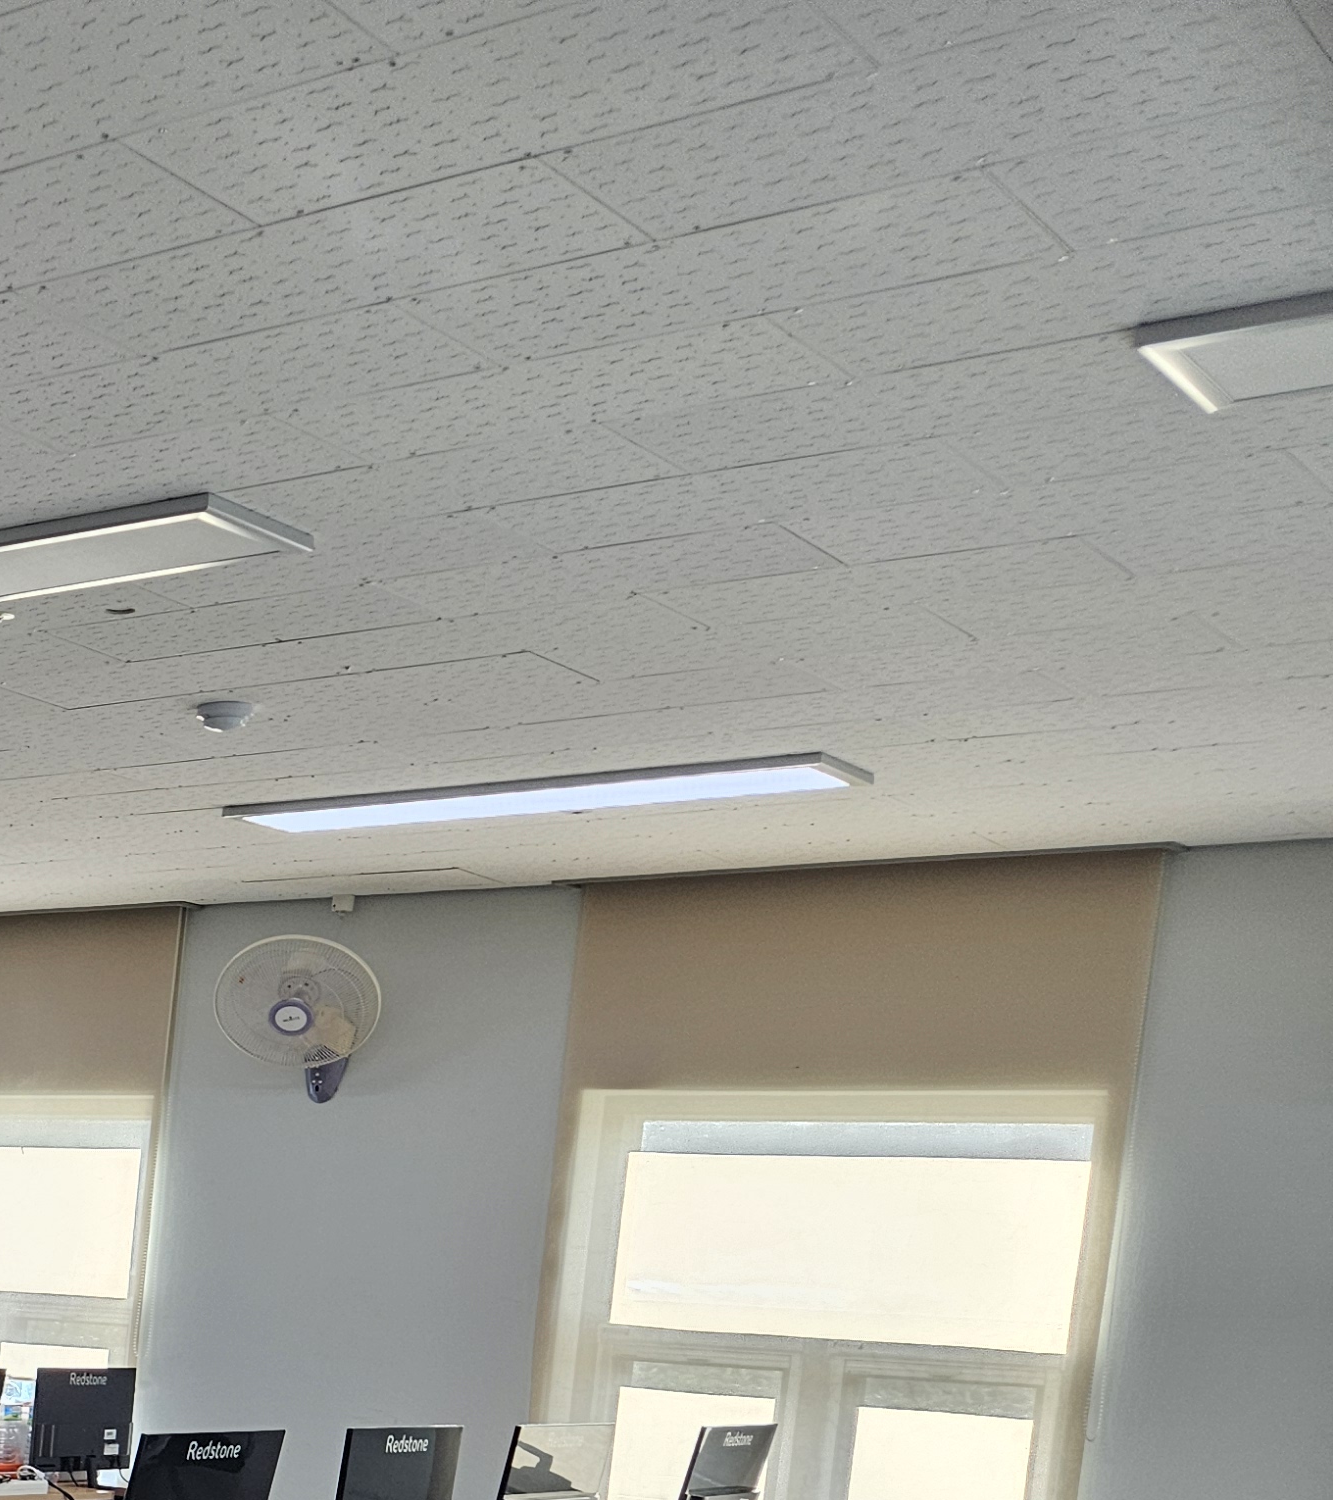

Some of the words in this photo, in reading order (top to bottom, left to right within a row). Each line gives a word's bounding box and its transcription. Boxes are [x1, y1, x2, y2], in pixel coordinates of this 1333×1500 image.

[69, 1371, 108, 1386] Redstone
[386, 1434, 429, 1454] Redstone
[723, 1431, 754, 1447] Redstone
[187, 1440, 242, 1461] Redstone
